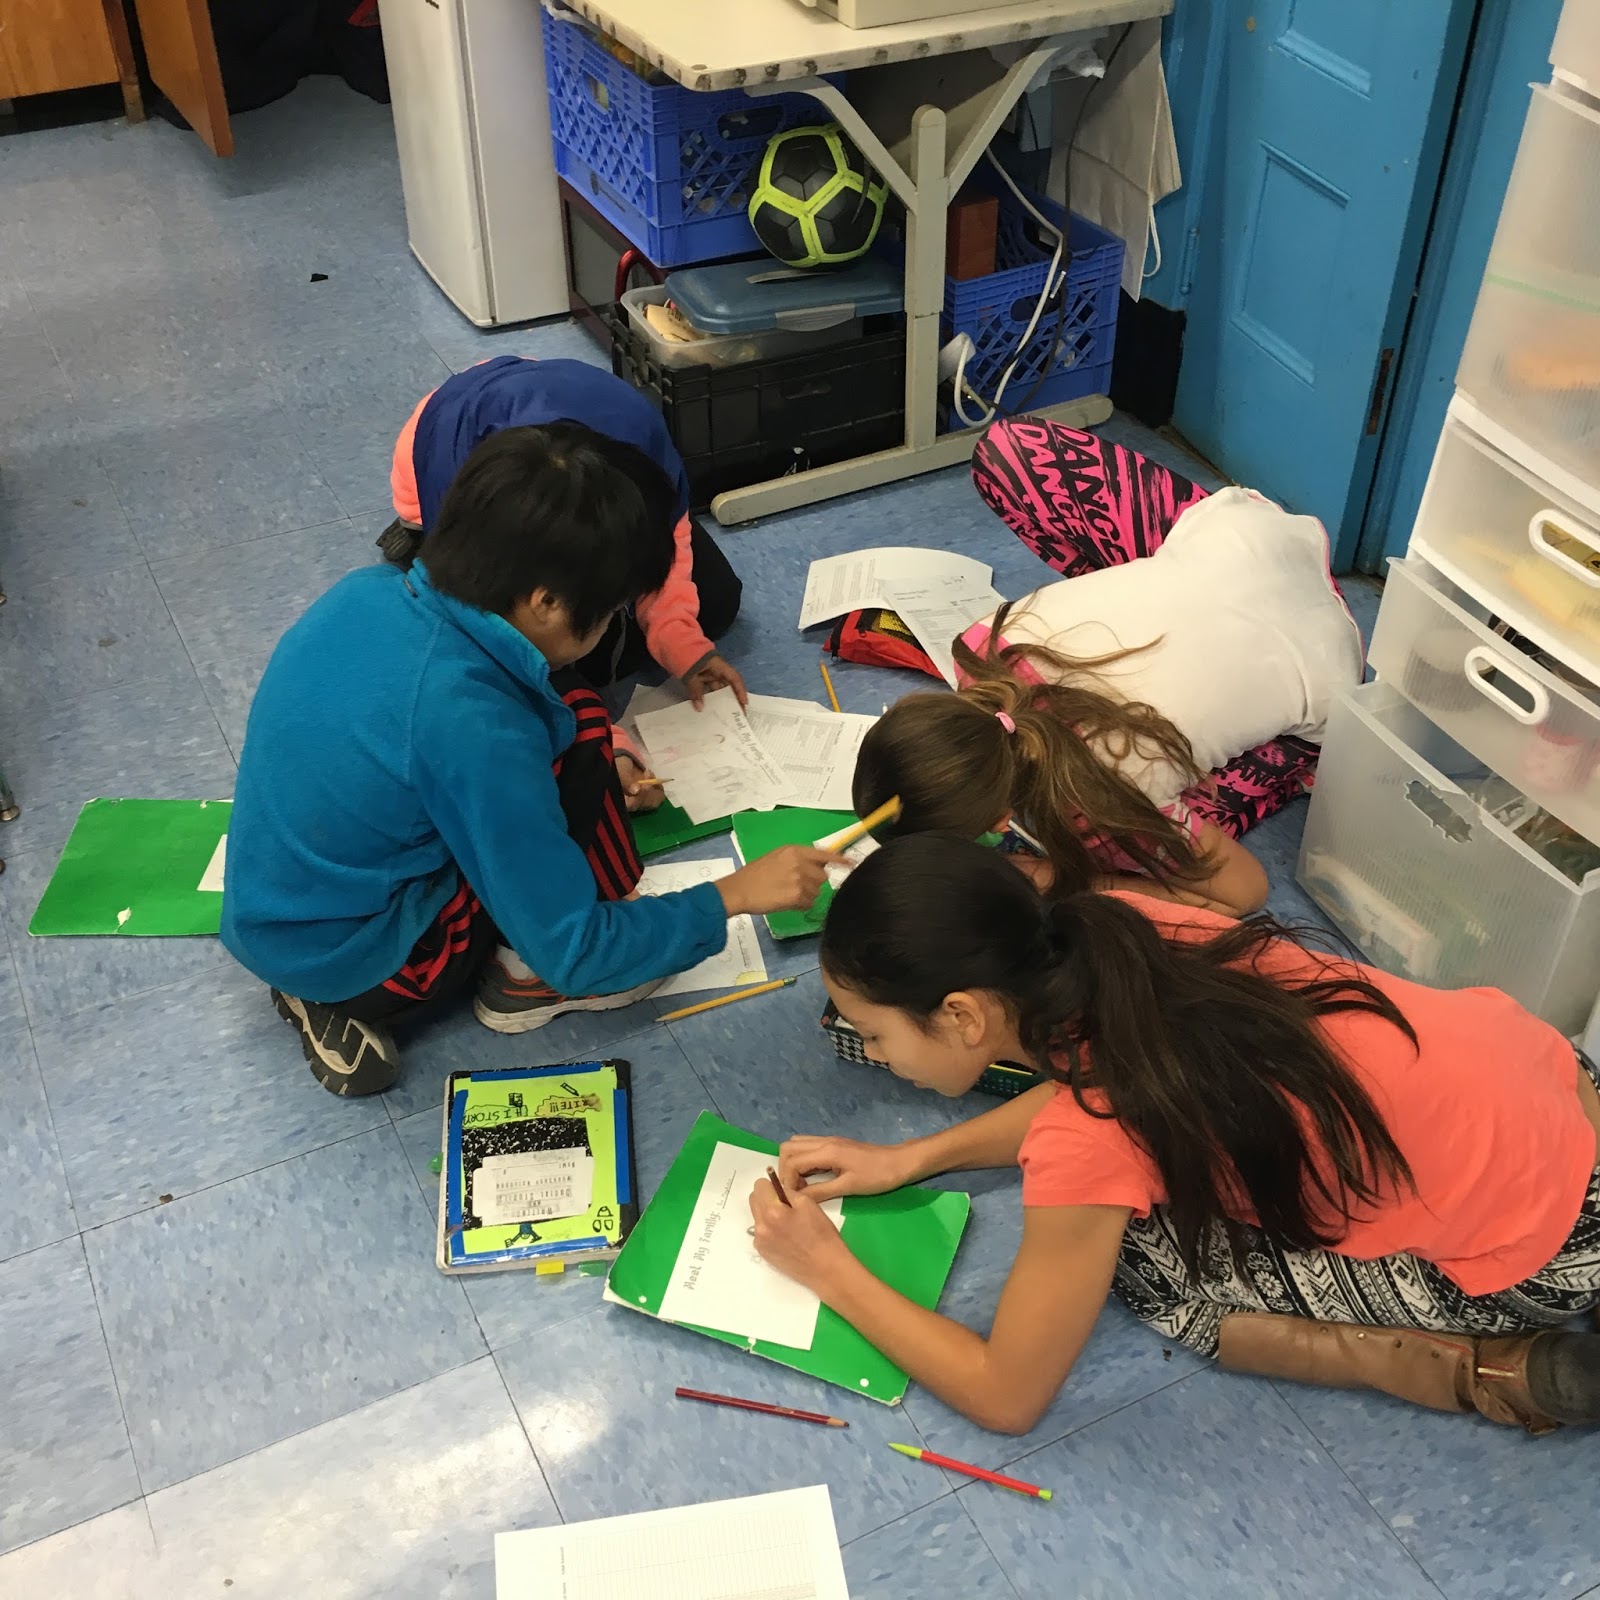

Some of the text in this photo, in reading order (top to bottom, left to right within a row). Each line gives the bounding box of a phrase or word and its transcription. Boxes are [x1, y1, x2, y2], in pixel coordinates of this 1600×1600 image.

[1010, 423, 1087, 537] DANCE
[683, 1265, 702, 1290] Meet
[693, 1247, 710, 1261] My
